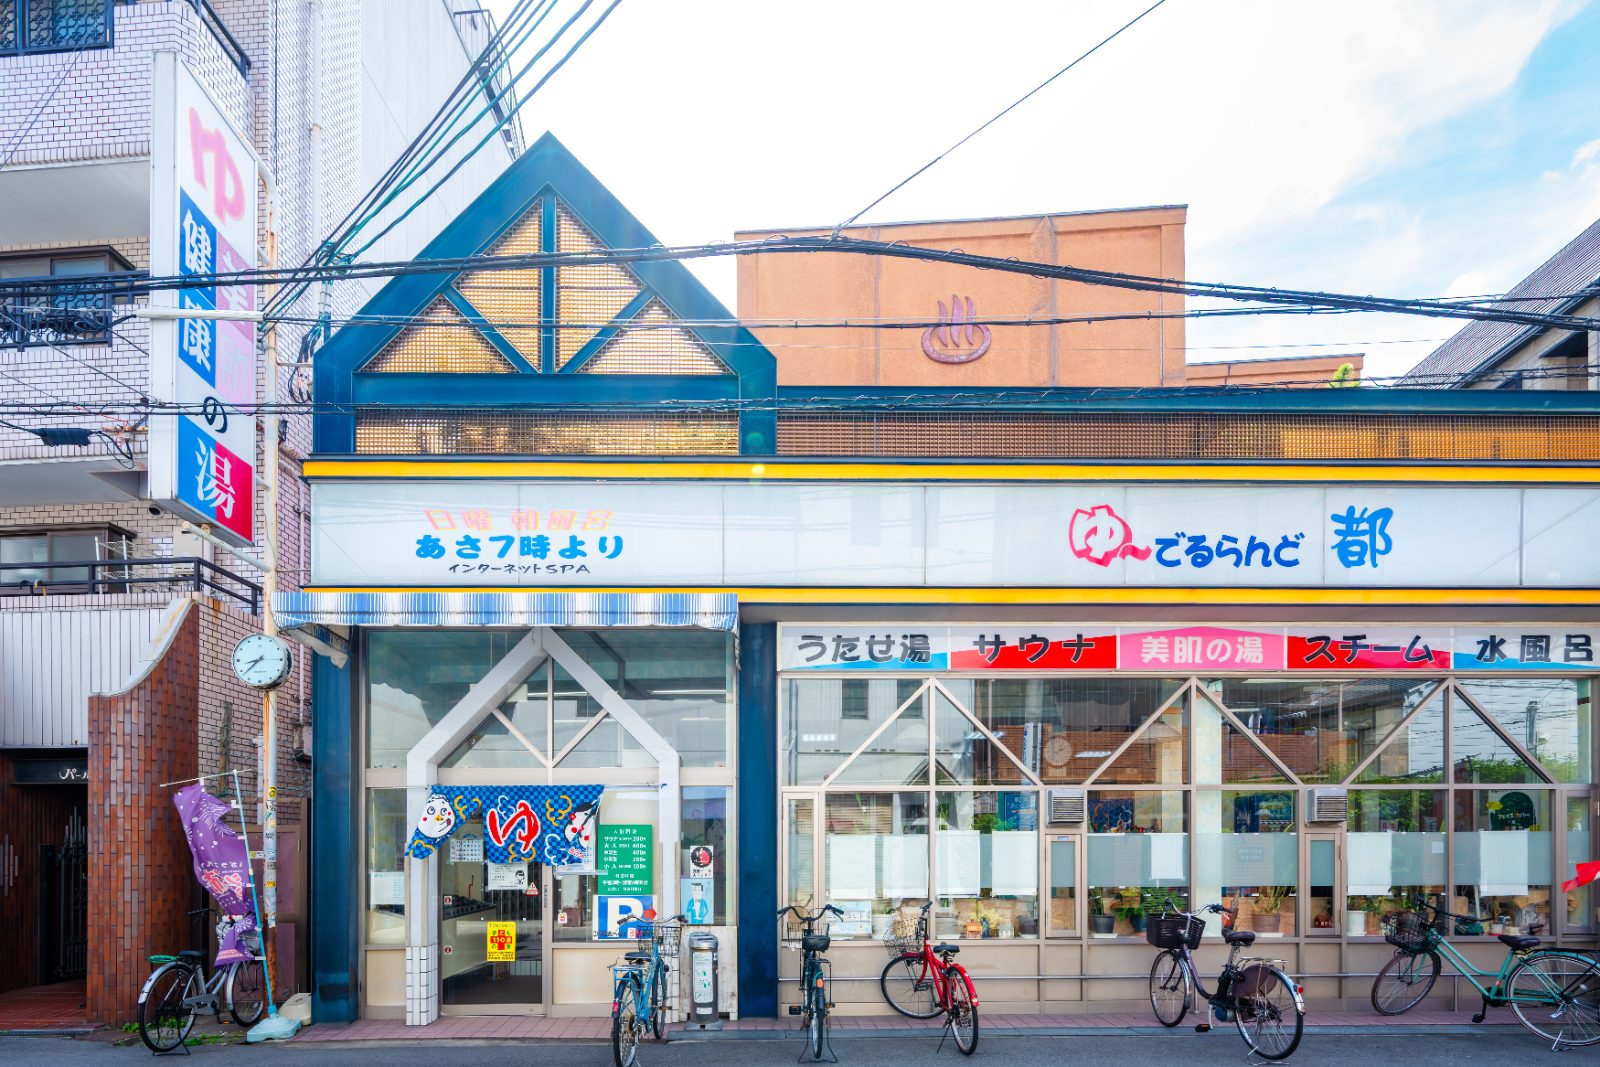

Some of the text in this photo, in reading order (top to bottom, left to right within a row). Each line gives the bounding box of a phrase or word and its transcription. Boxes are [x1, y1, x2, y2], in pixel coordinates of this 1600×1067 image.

[189, 106, 246, 226] ゆ
[183, 208, 213, 370] 健康
[415, 534, 623, 560] あさ7時より
[1331, 505, 1393, 568] 都
[448, 563, 591, 574] インターネットSPA
[798, 633, 931, 664] うたせ湯
[973, 633, 1096, 664] サウナ
[1140, 635, 1264, 664] 美肌の湯
[1303, 633, 1435, 664] スチーム
[1476, 634, 1593, 663] 水風呂
[486, 800, 541, 853] ゆ
[607, 897, 644, 938] P
